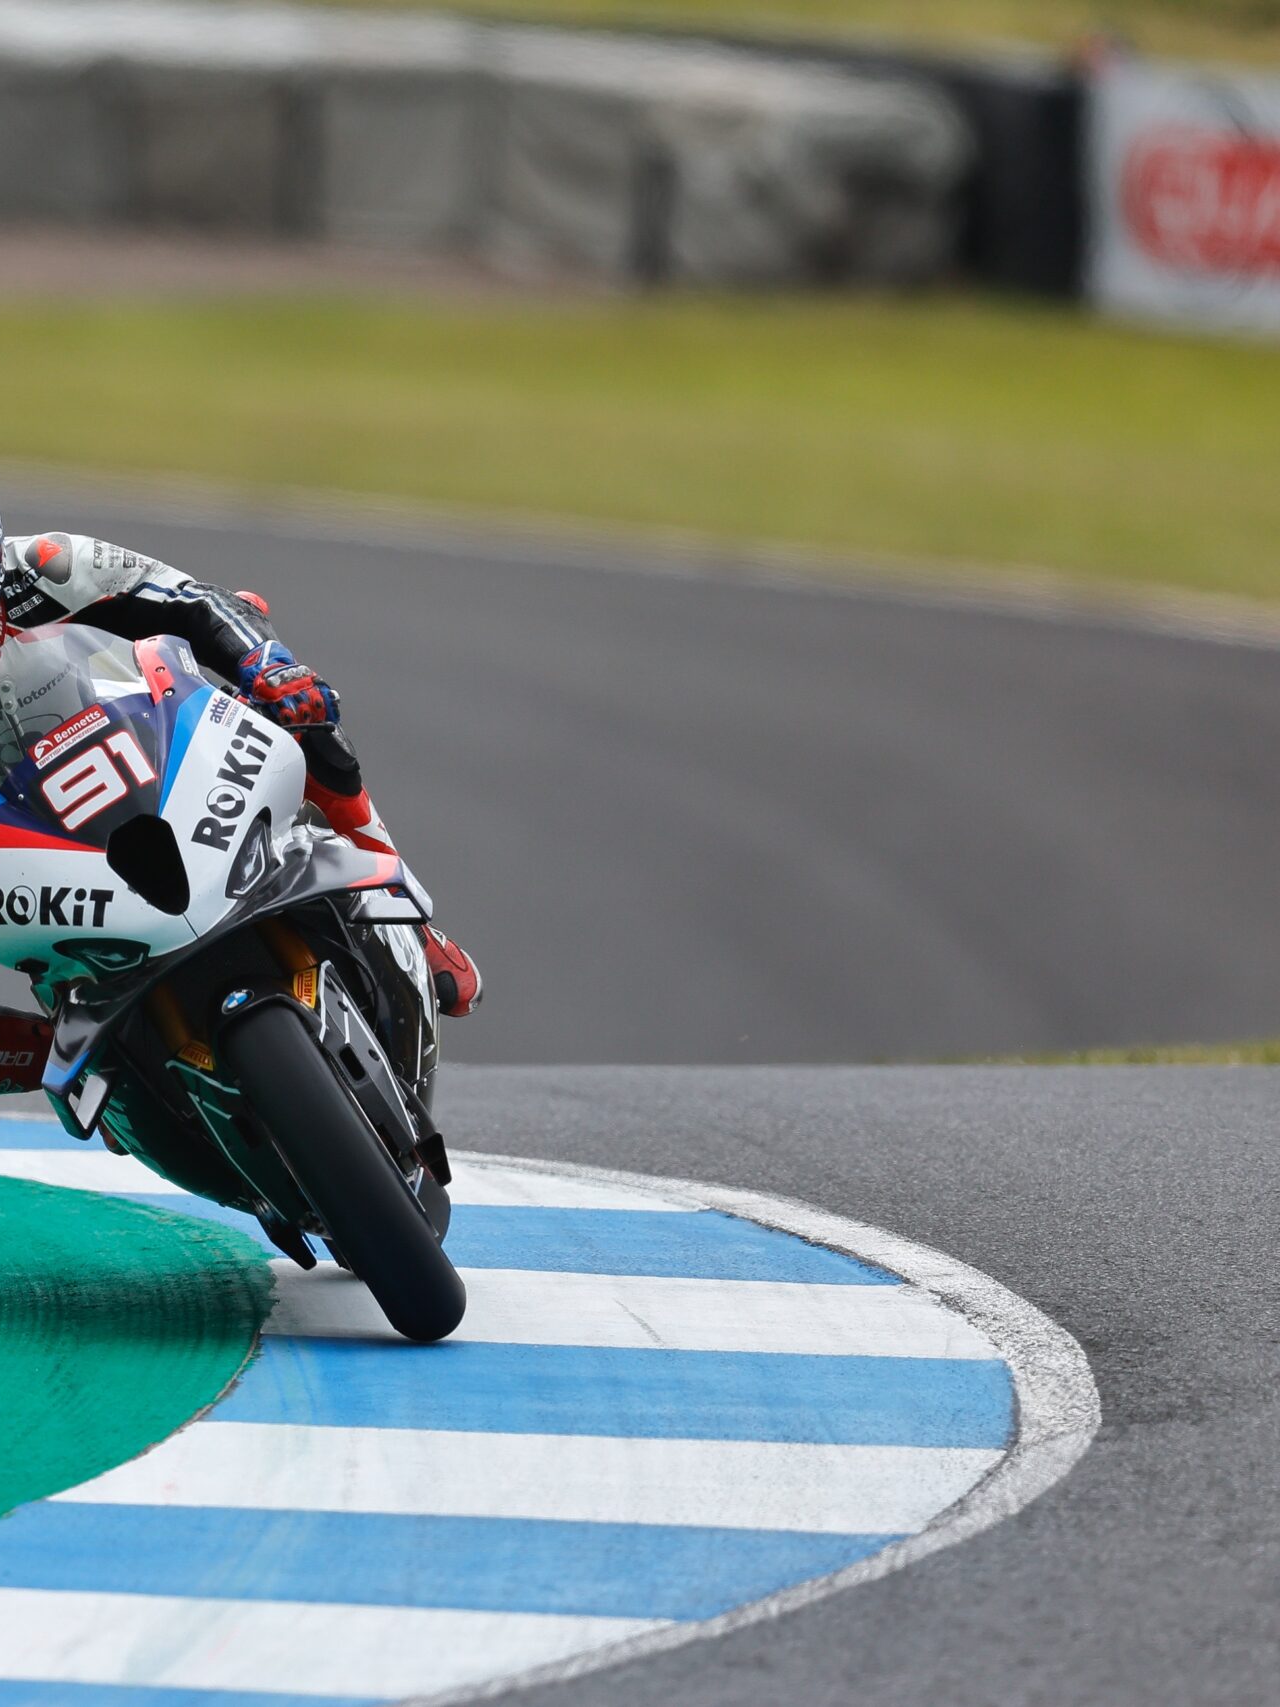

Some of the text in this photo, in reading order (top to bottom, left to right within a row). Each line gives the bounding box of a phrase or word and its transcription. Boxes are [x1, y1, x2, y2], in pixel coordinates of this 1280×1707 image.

[53, 710, 102, 744] Bennetts
[210, 697, 232, 724] attis
[41, 731, 157, 831] 91
[191, 718, 274, 852] ROKiT
